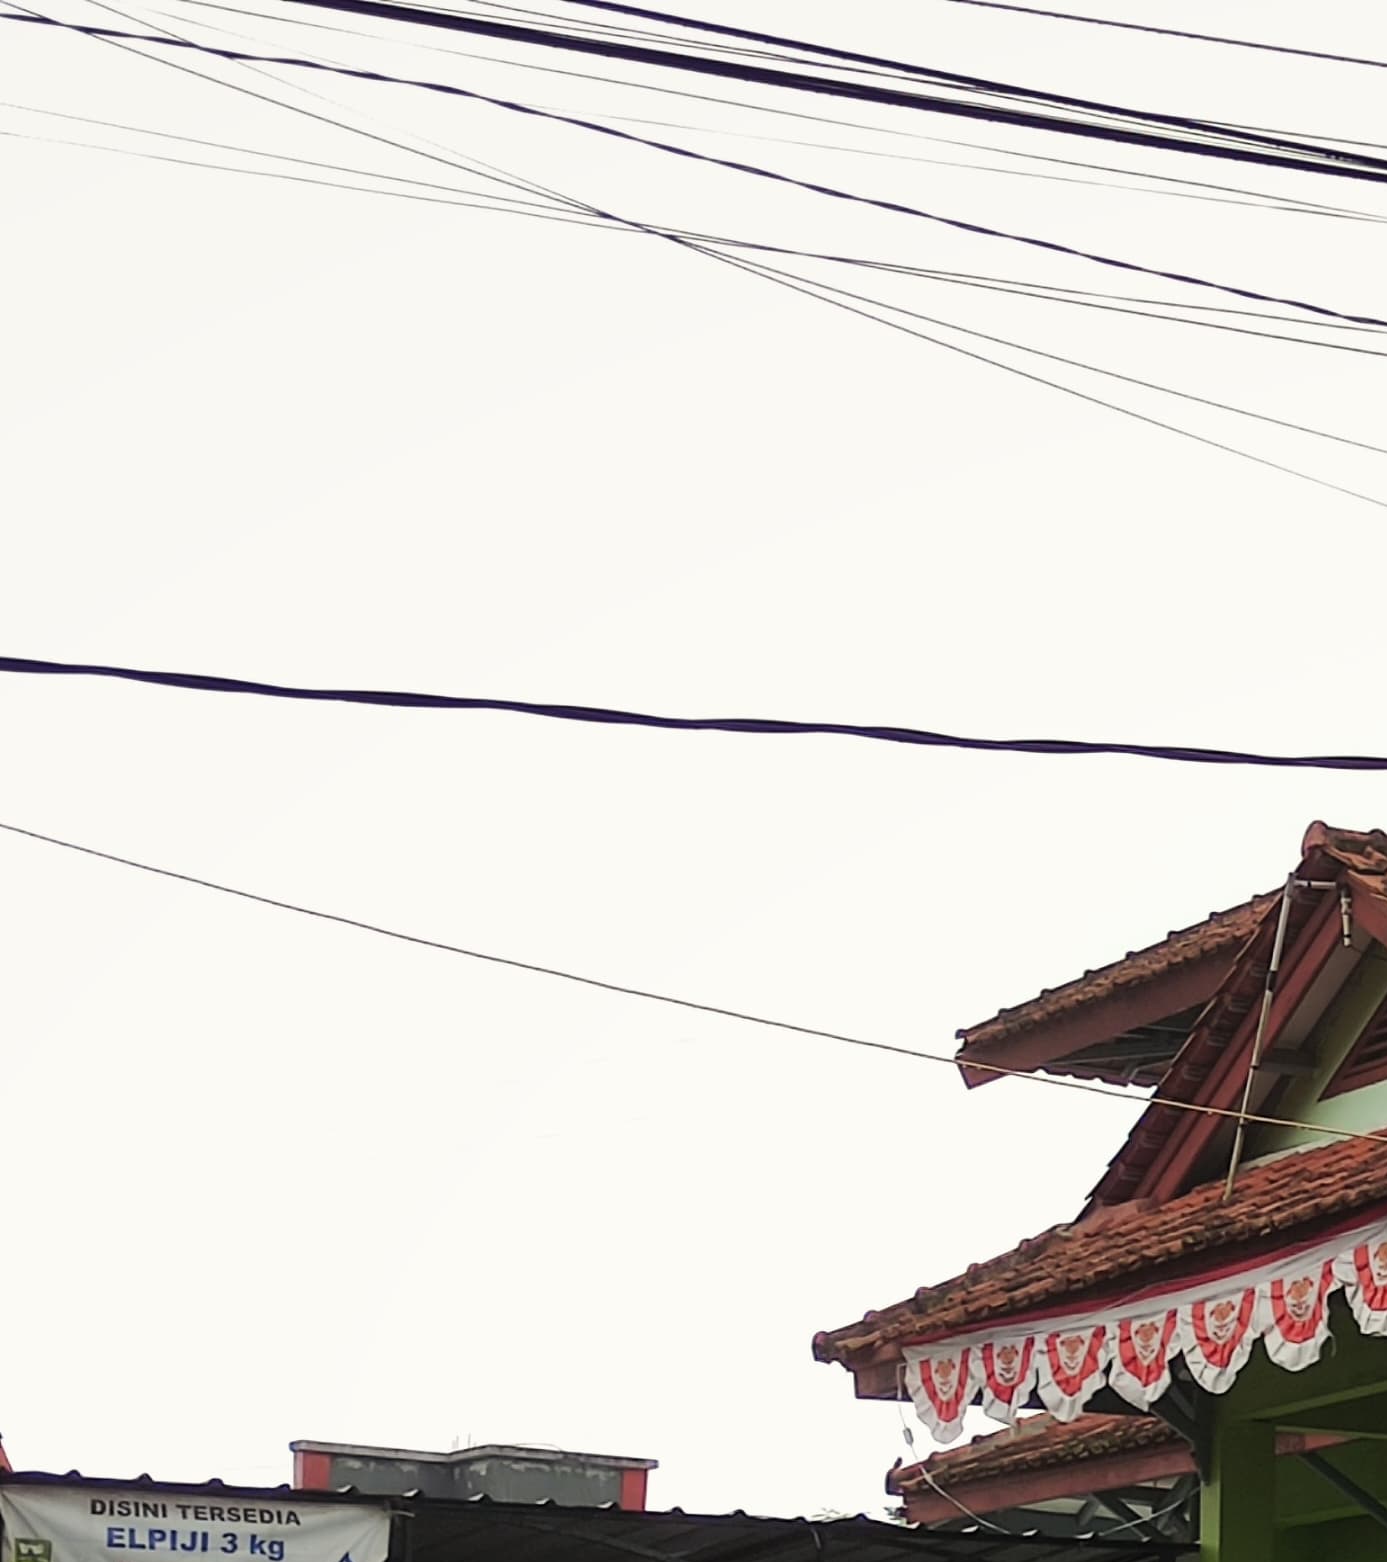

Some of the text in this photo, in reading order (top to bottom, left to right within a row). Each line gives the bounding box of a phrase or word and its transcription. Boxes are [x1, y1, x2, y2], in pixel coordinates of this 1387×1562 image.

[90, 1499, 301, 1526] DISINI TERSEDIA
[106, 1527, 285, 1561] ELPIJI 3 kg
